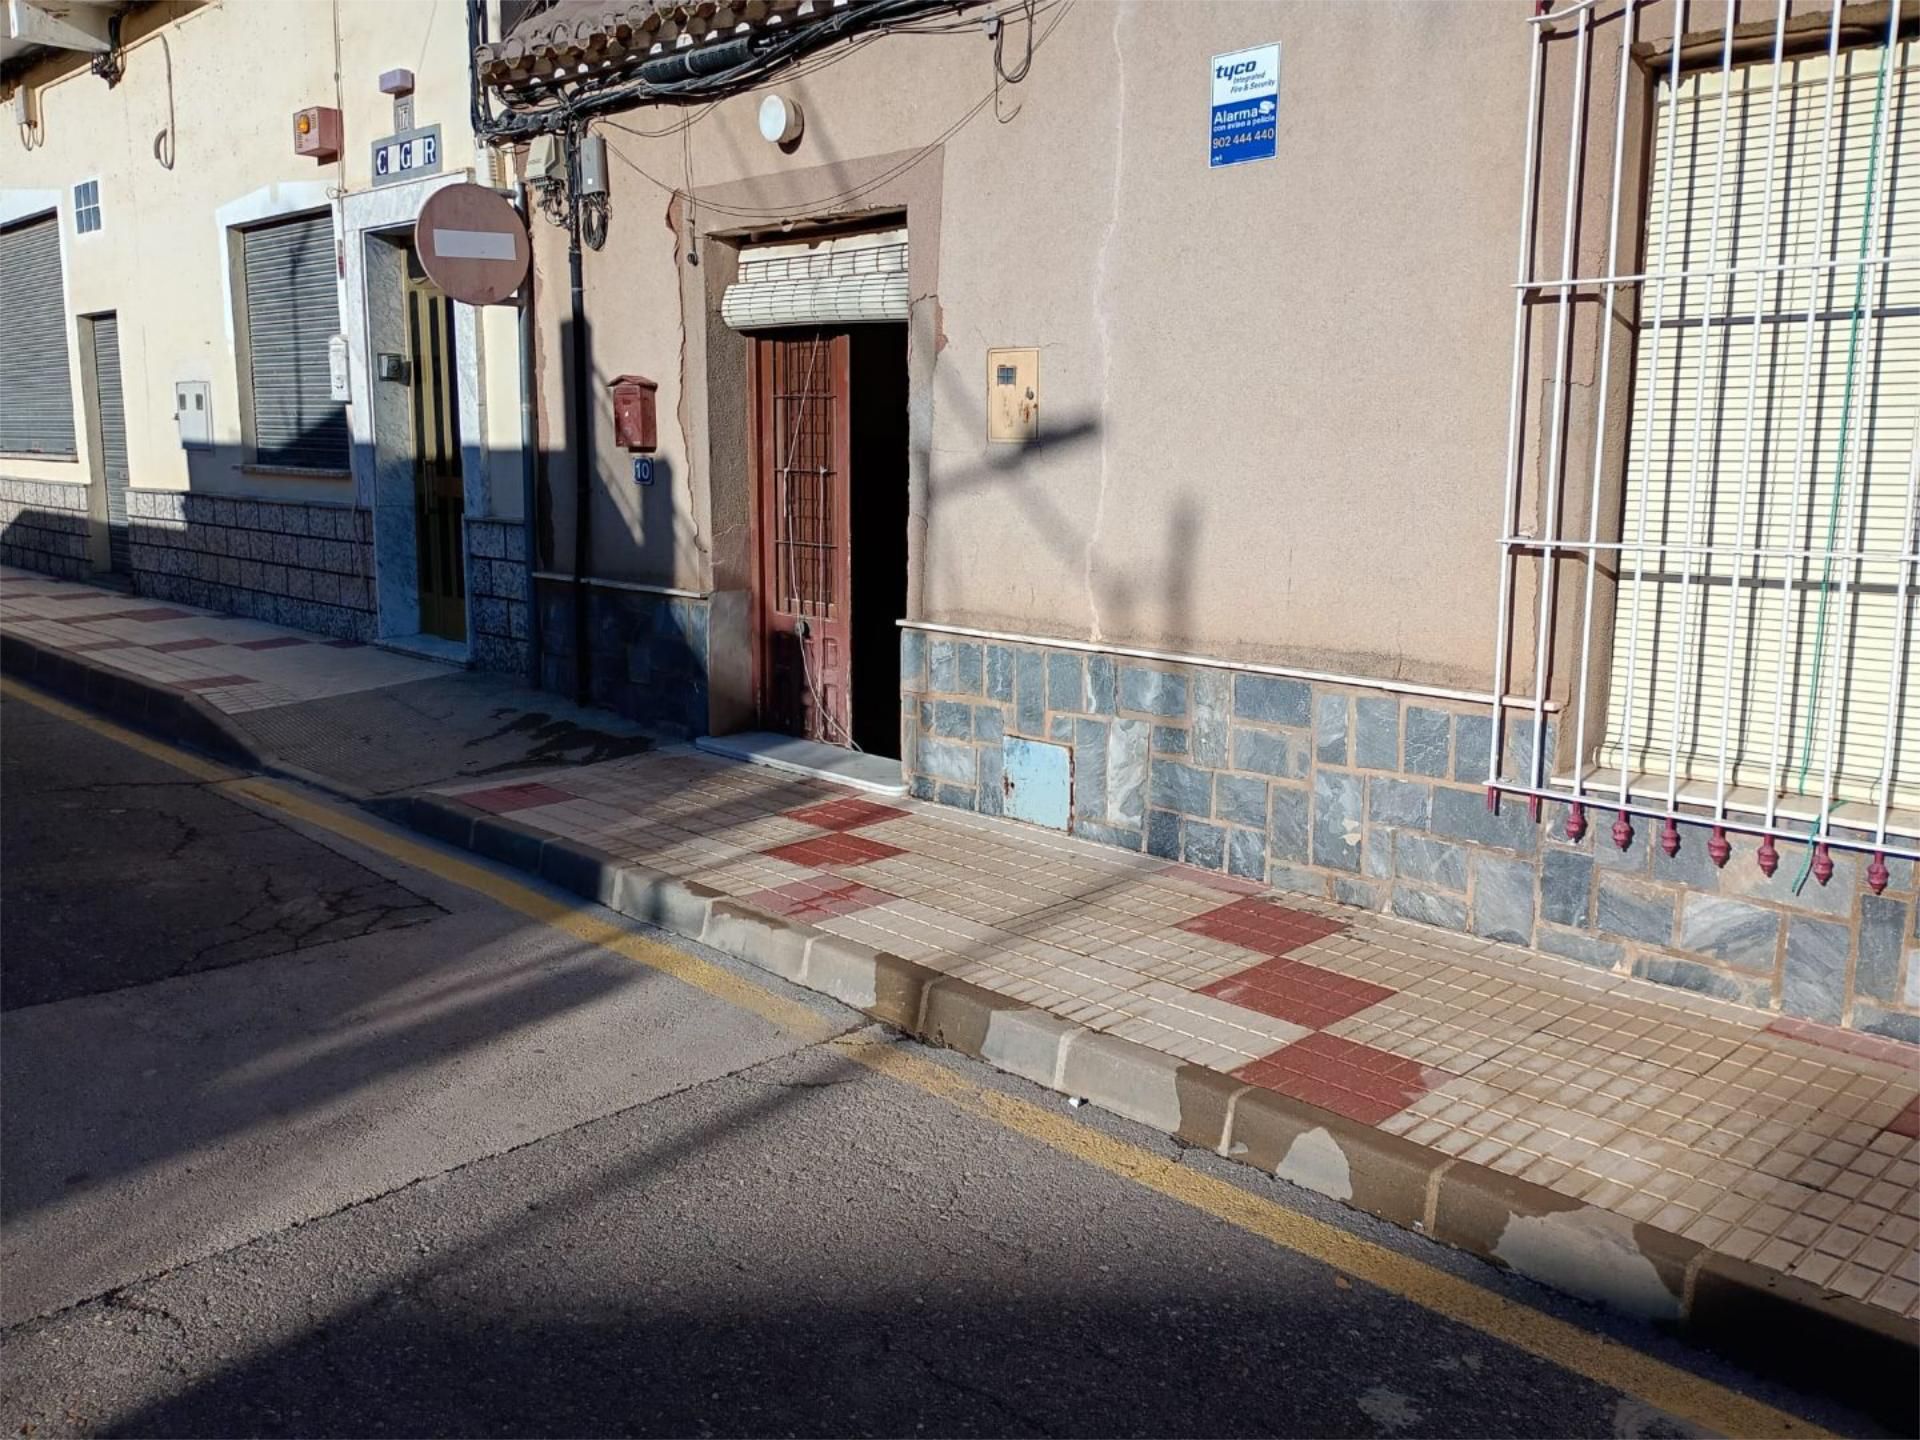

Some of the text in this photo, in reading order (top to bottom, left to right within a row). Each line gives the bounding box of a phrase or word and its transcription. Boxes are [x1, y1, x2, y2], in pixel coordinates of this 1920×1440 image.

[1216, 60, 1257, 80] tyco
[1249, 79, 1275, 90] Security
[1214, 107, 1258, 125] Alarma
[1212, 128, 1274, 149] 902 444 440
[635, 462, 649, 479] 10
